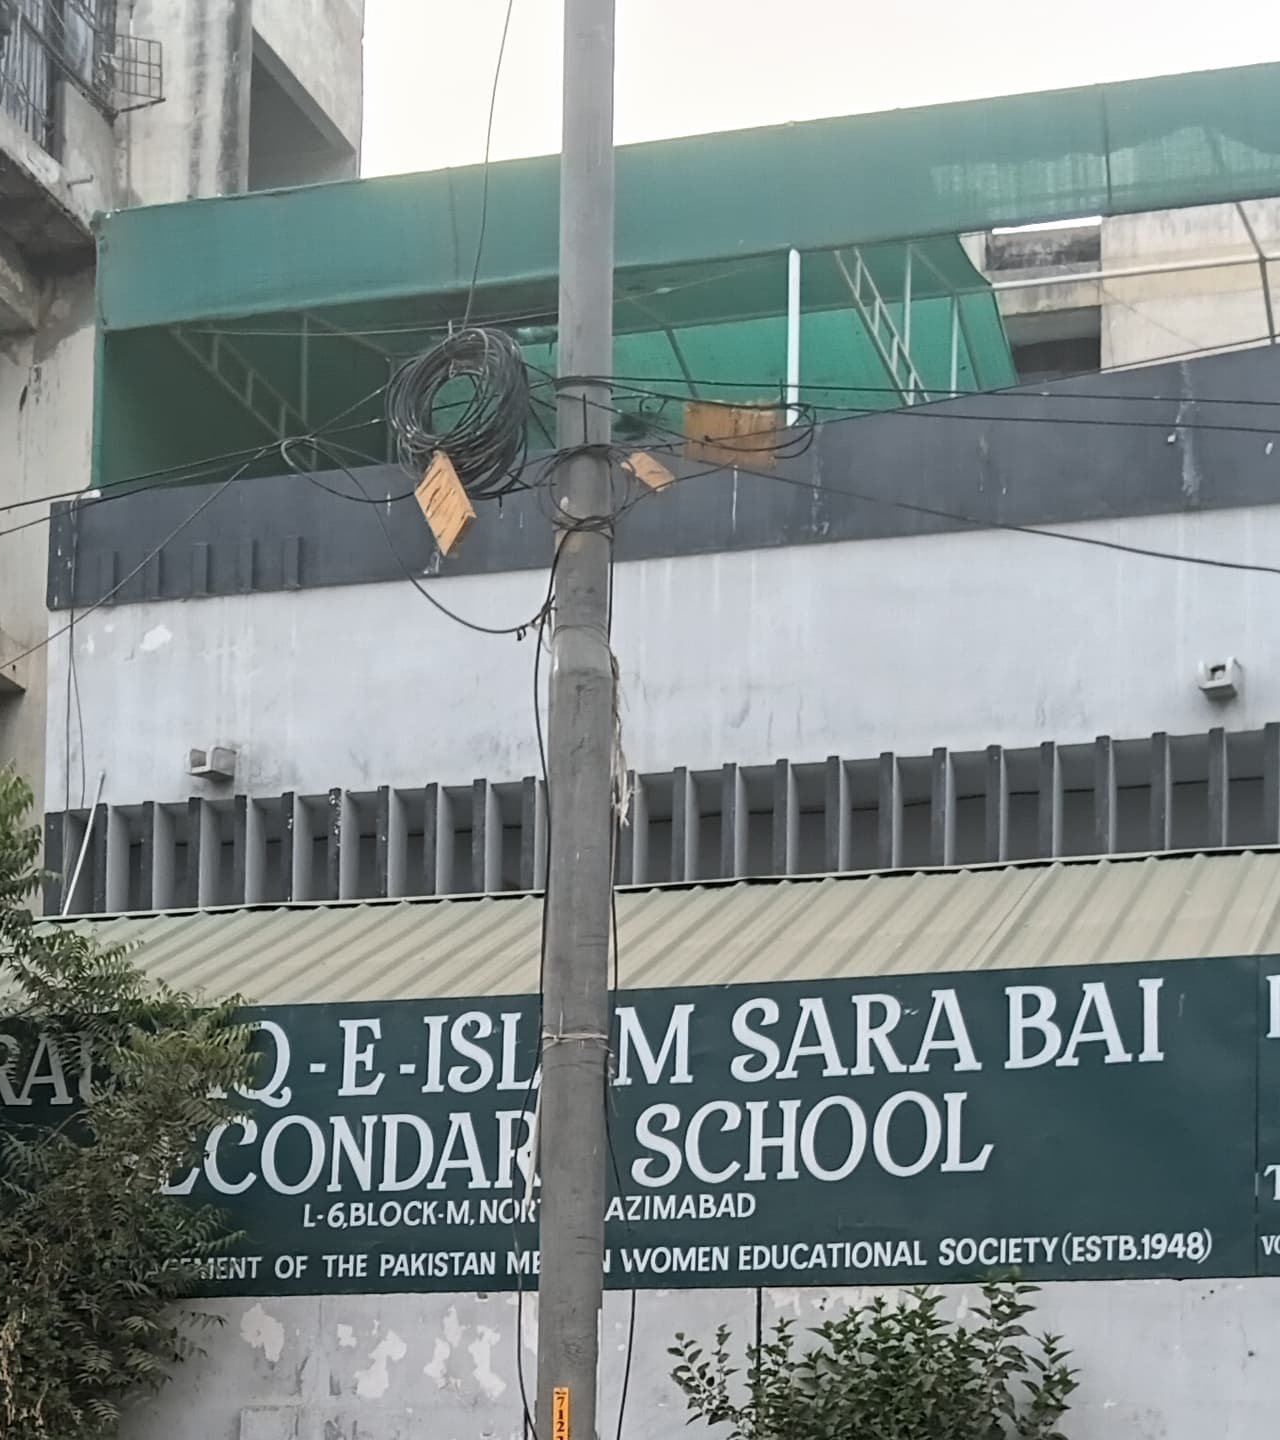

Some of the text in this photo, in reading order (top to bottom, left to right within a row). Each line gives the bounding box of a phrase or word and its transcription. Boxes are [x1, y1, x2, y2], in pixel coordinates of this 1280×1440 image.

[730, 988, 982, 1083] SARA
[1004, 977, 1165, 1070] BAI
[631, 1090, 994, 1188] SCHOOL
[479, 1197, 541, 1226] NOR
[603, 1193, 756, 1222] AZIMABAD
[274, 1254, 308, 1280] OF
[322, 1253, 368, 1278] THE
[379, 1251, 497, 1277] PAKISTAN
[621, 1246, 729, 1274] WOMEN
[738, 1240, 927, 1271] EDUCATIONAL
[939, 1236, 1058, 1266] SOCIETY
